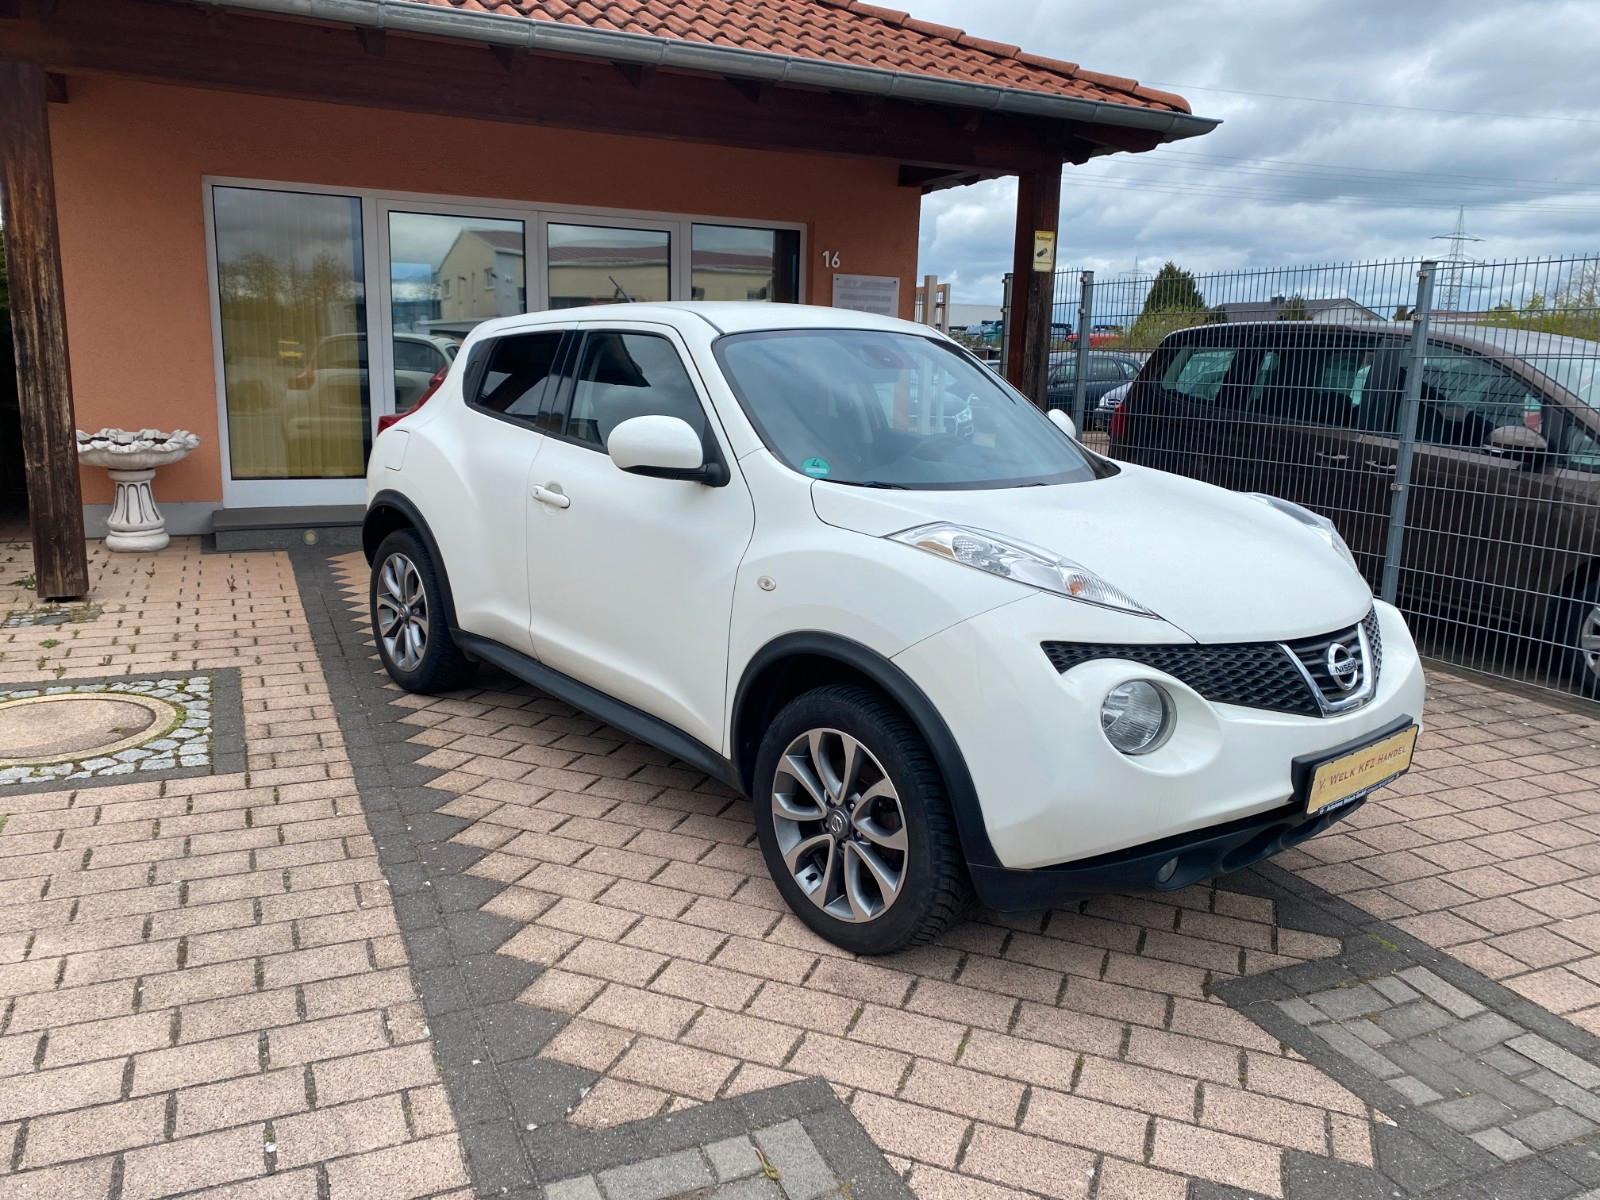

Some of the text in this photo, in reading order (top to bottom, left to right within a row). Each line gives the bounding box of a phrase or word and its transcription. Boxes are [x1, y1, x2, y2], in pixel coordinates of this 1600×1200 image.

[822, 250, 841, 269] 16
[1329, 767, 1355, 785] WELK
[1358, 758, 1375, 773] KFZ
[1378, 746, 1405, 764] HANDEL
